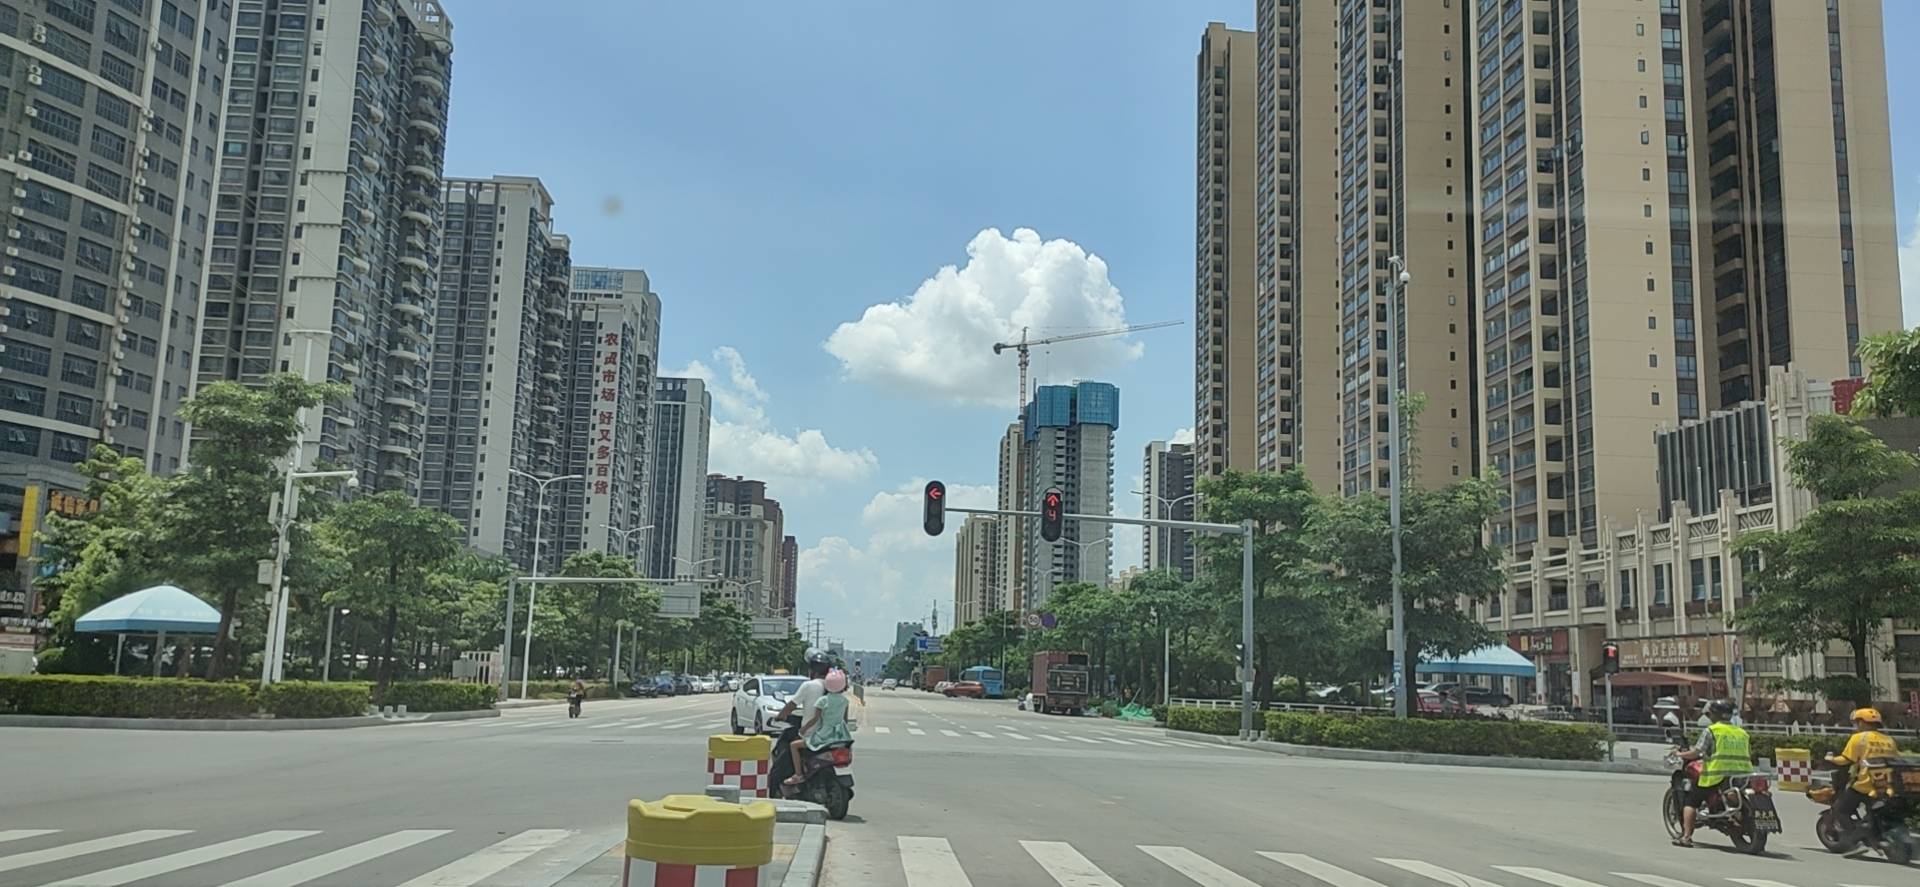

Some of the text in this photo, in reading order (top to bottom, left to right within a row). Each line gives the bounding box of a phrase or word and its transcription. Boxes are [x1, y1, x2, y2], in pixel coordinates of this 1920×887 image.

[594, 411, 614, 495] 好又多百货
